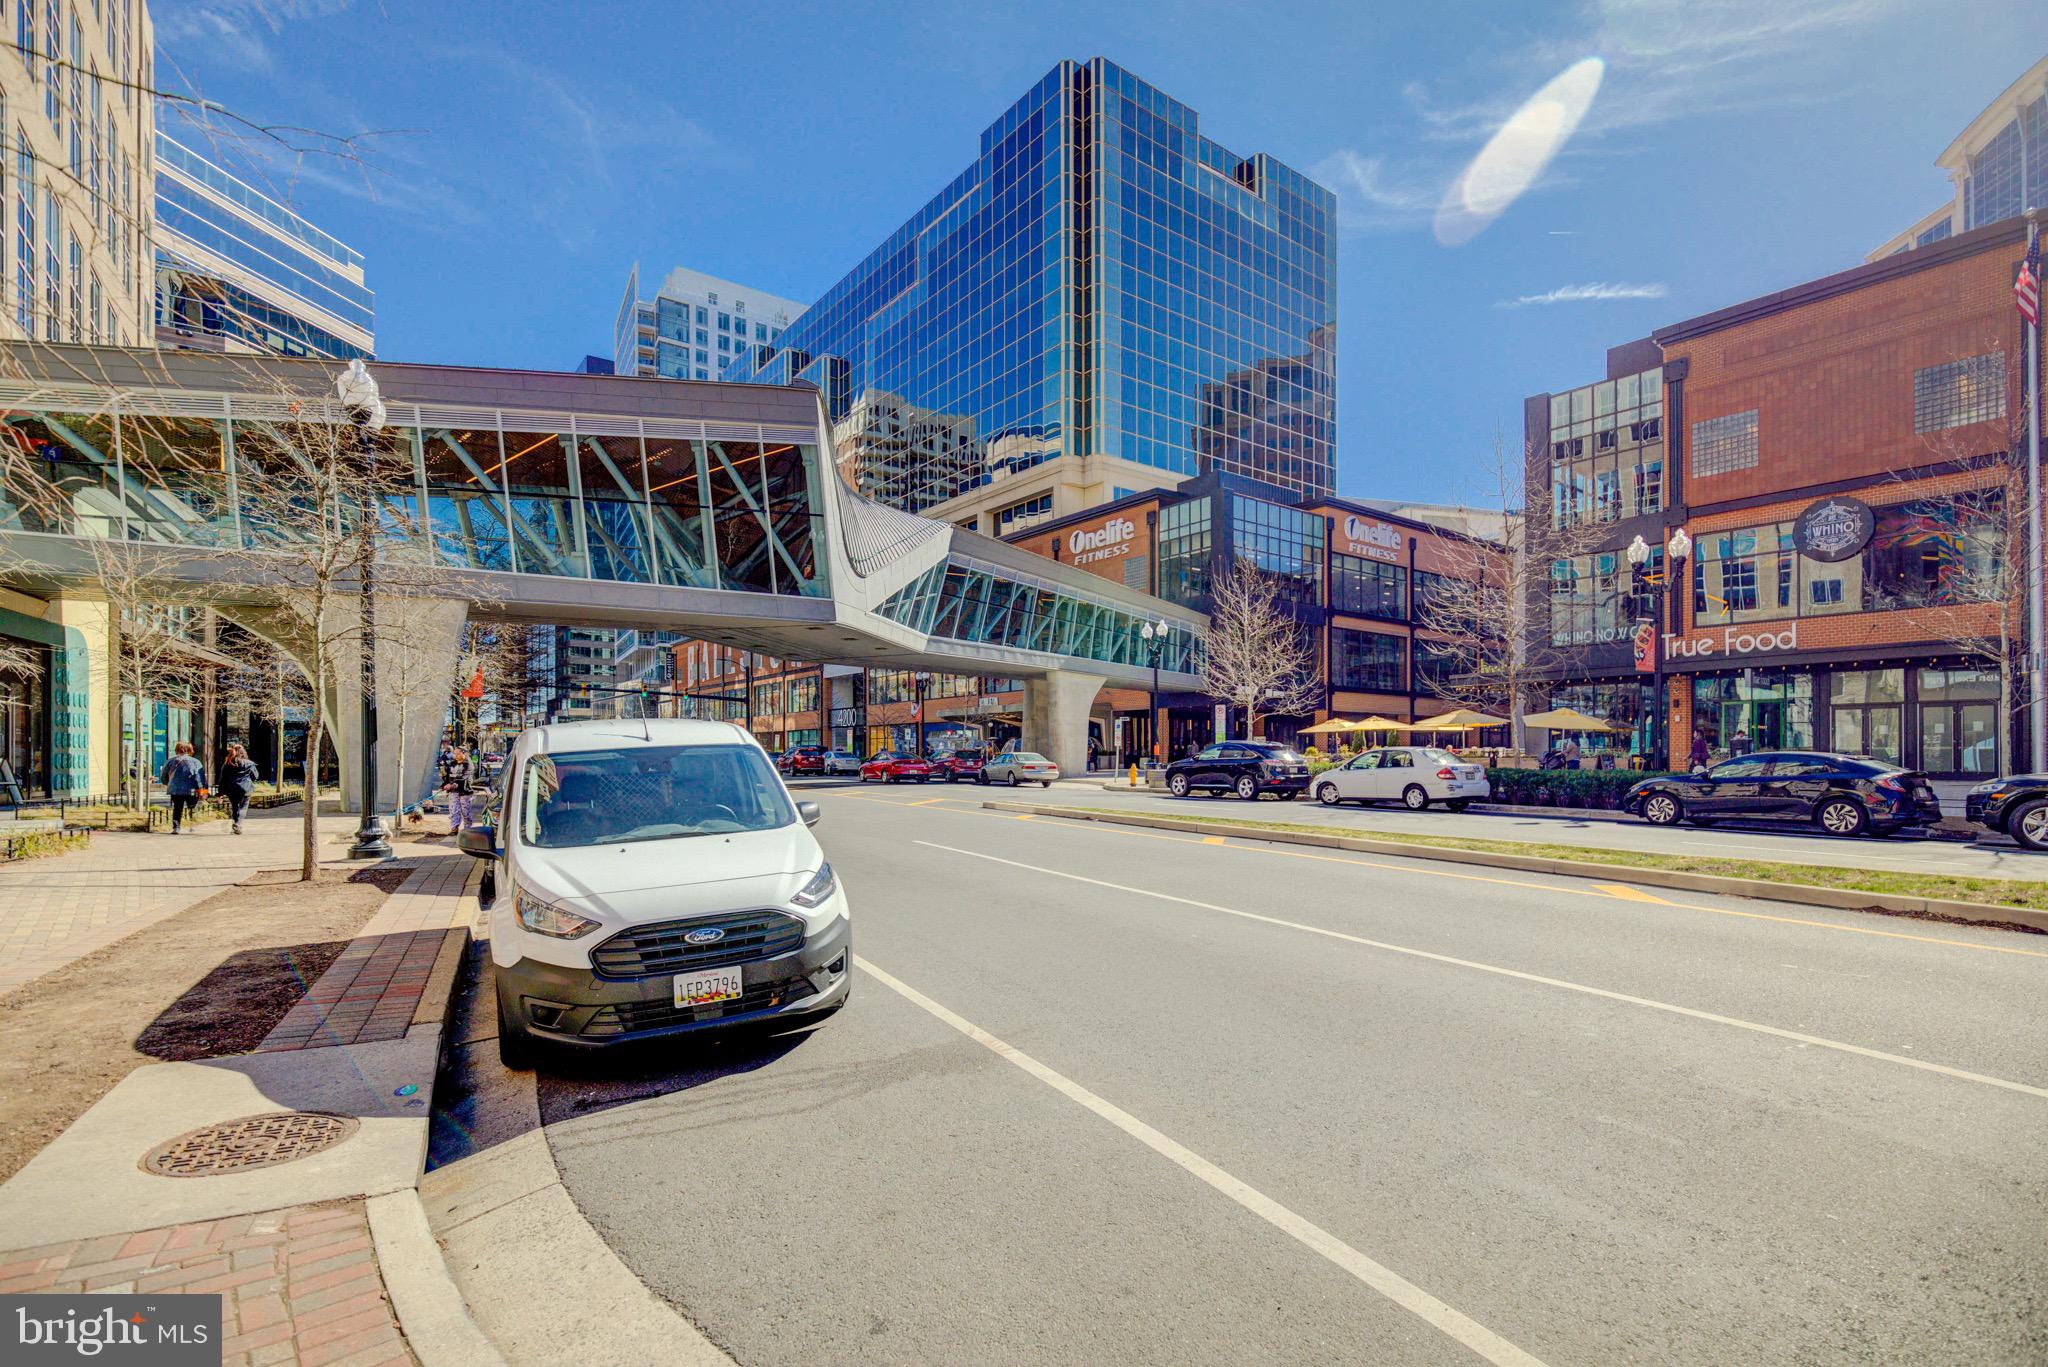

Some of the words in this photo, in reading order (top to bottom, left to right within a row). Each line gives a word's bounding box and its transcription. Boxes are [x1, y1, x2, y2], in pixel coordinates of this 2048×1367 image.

[1069, 518, 1135, 554] Onelife
[1344, 514, 1401, 550] Onelife
[1812, 521, 1855, 537] WHINO
[1074, 543, 1130, 566] FITNESS
[1349, 542, 1398, 561] FITNESS
[1552, 631, 1593, 643] WHINO
[1661, 633, 1714, 660] True
[1725, 622, 1797, 656] Food
[837, 709, 857, 727] 4200
[694, 930, 716, 942] Ford
[679, 975, 738, 1002] 1EP3796
